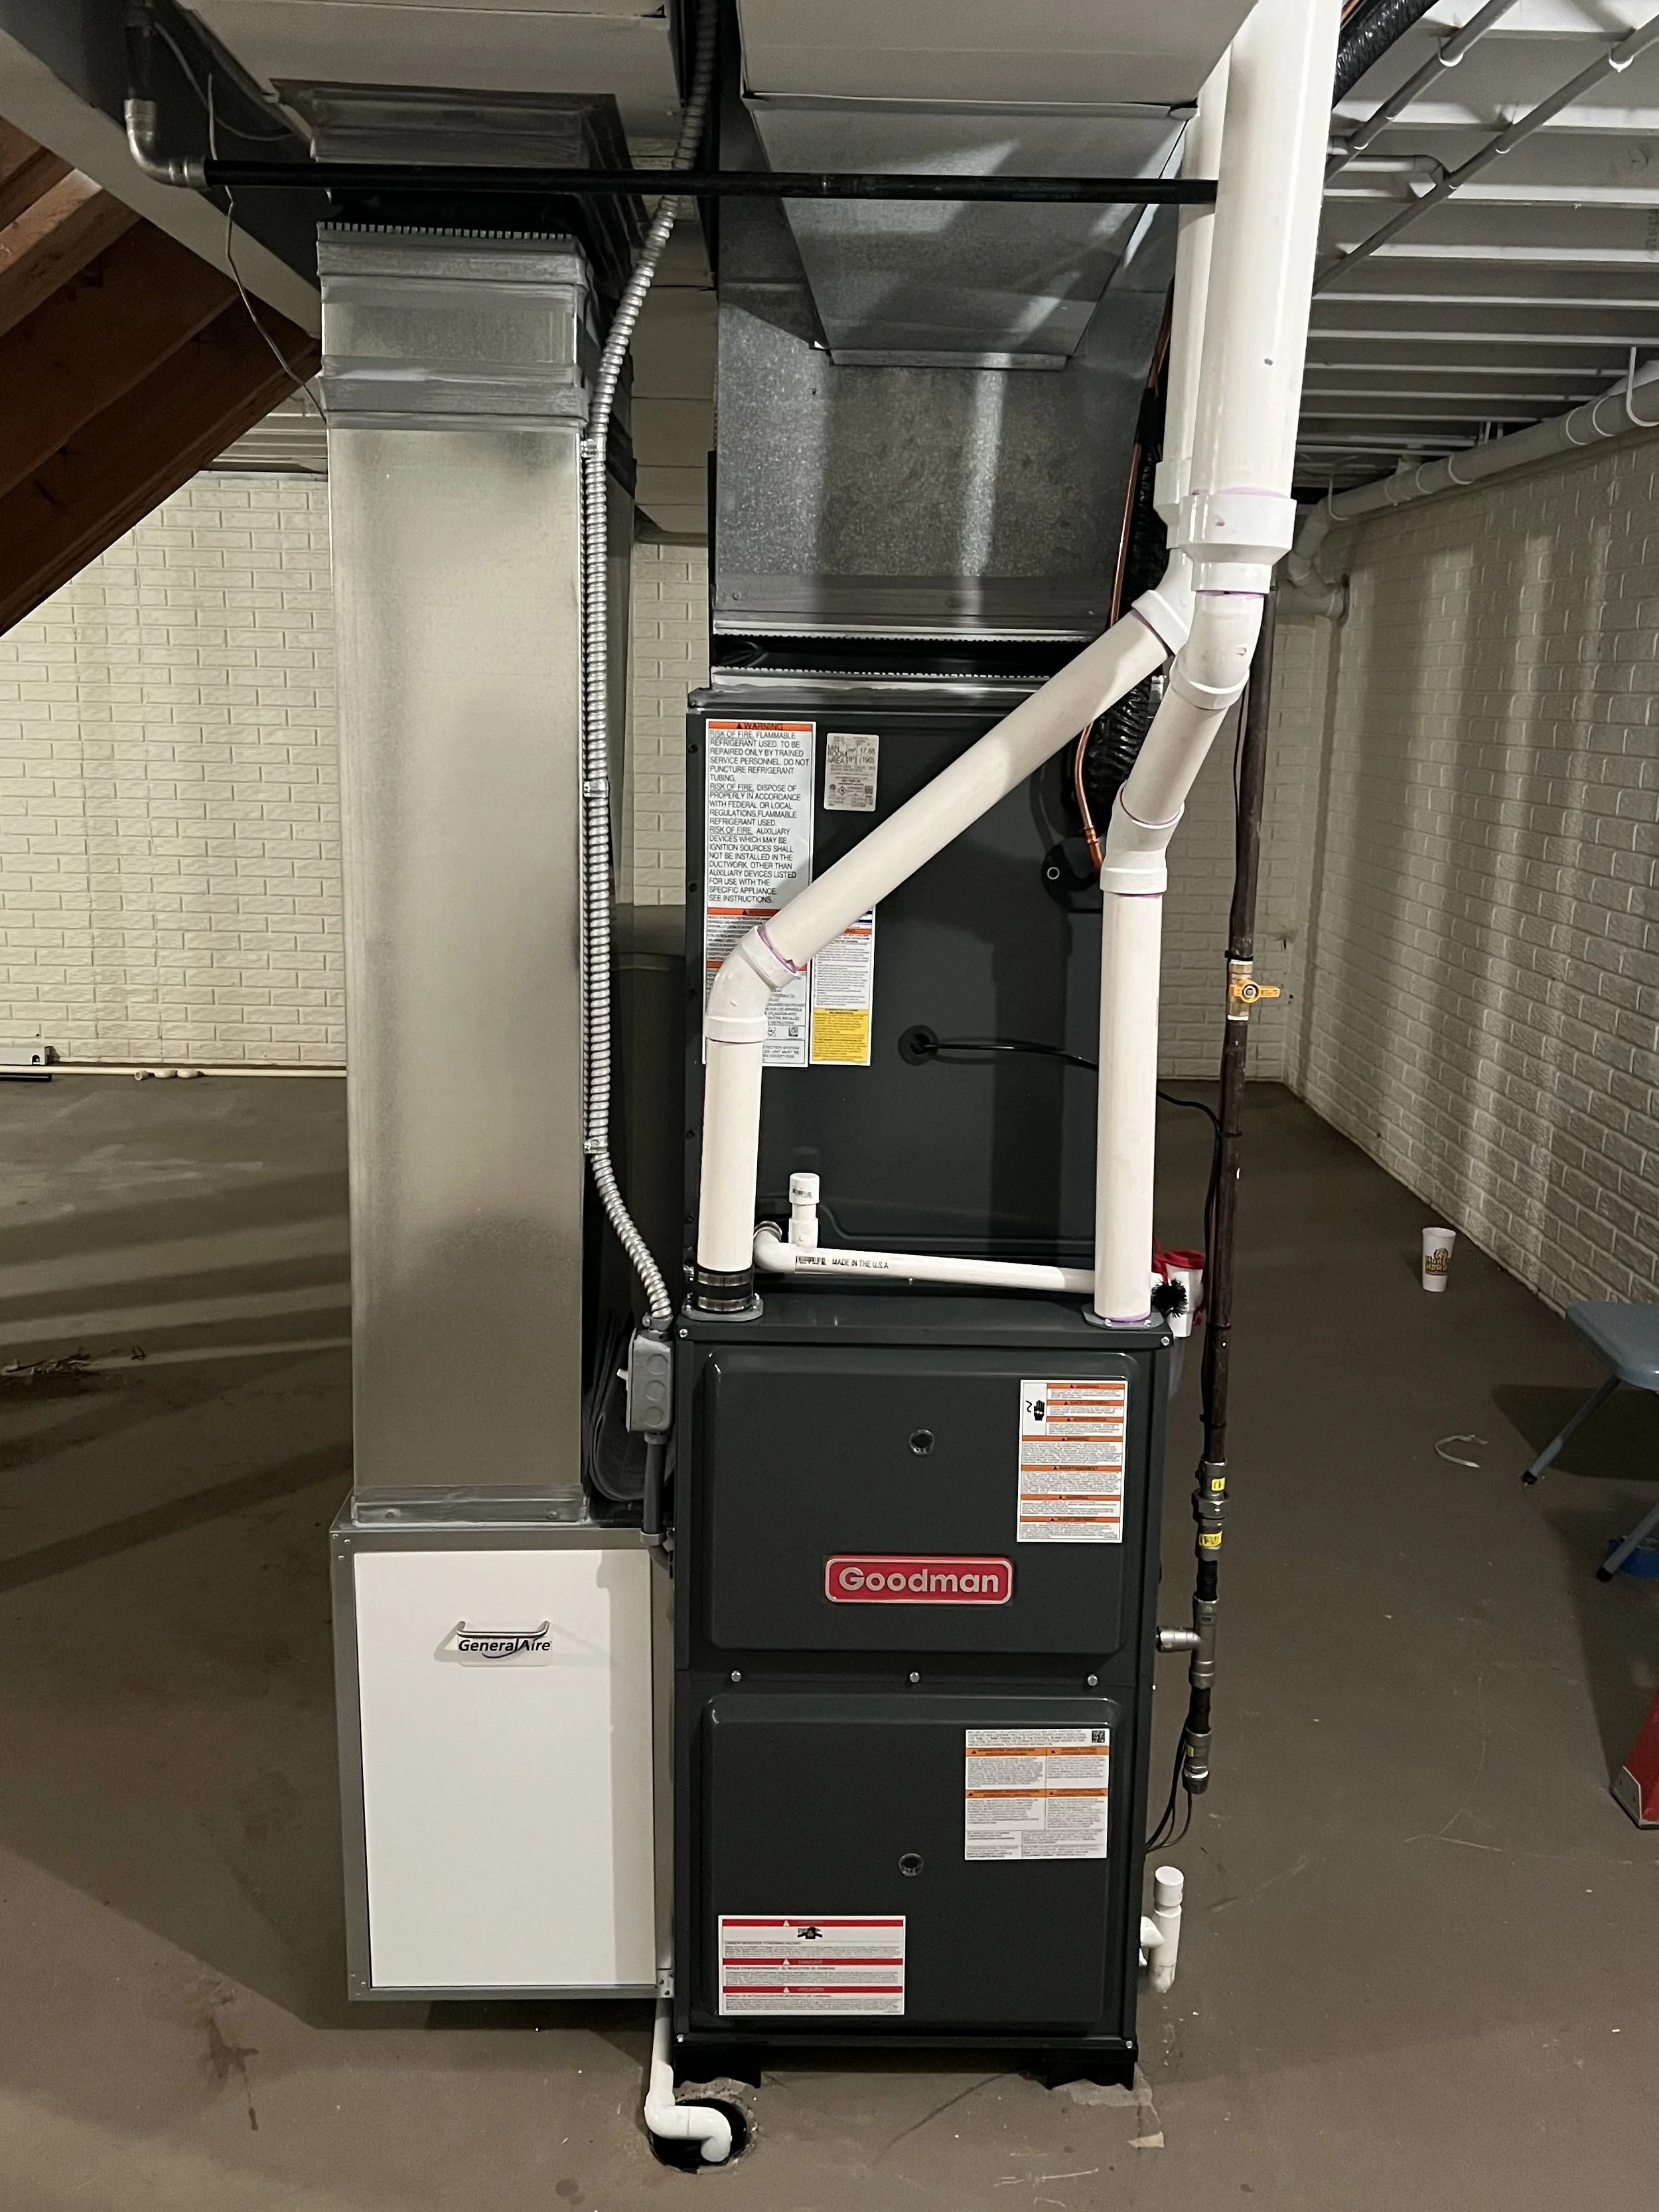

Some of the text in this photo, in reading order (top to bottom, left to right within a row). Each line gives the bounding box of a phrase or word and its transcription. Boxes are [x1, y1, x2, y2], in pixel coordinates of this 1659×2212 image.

[832, 1258, 849, 1266] MADE
[839, 1567, 999, 1593] Goodman
[459, 1638, 551, 1651] GeneralAire
